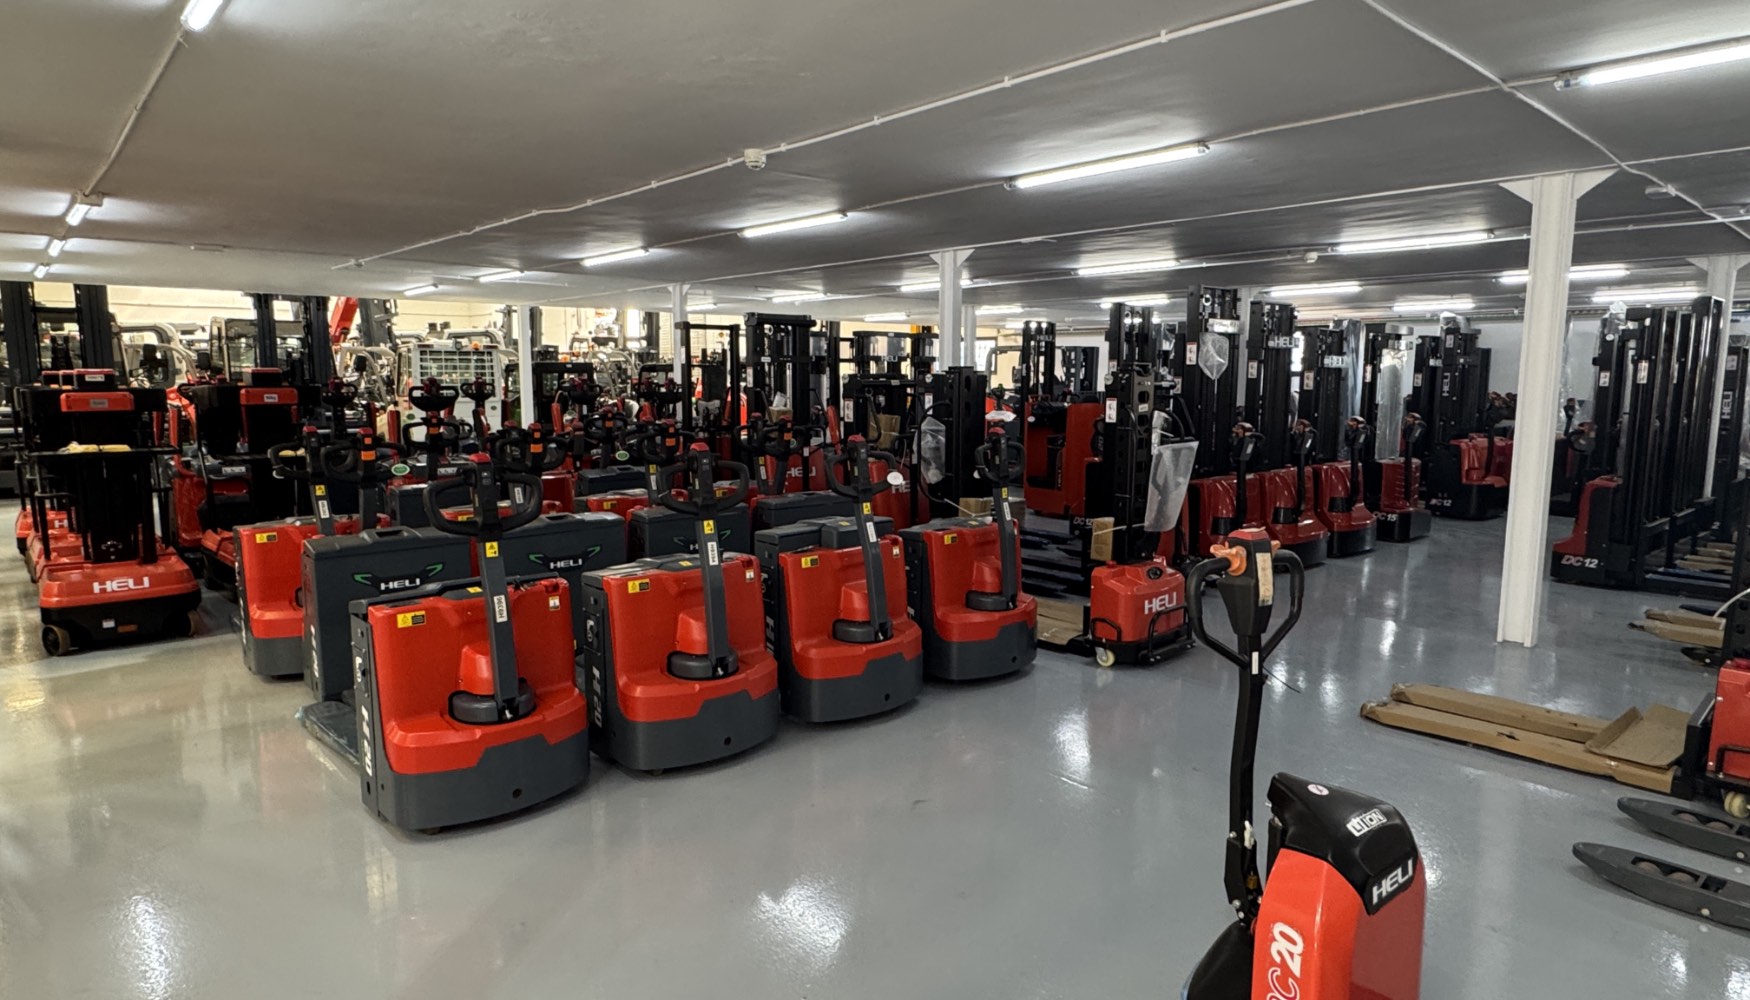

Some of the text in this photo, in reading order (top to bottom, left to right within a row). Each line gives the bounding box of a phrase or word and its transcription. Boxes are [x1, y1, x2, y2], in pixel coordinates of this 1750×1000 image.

[1721, 391, 1733, 419] HELI
[550, 558, 582, 570] HELI
[92, 576, 150, 594] HELI
[381, 578, 420, 590] HELI
[1144, 592, 1177, 615] HELI
[1372, 859, 1414, 905] HELI
